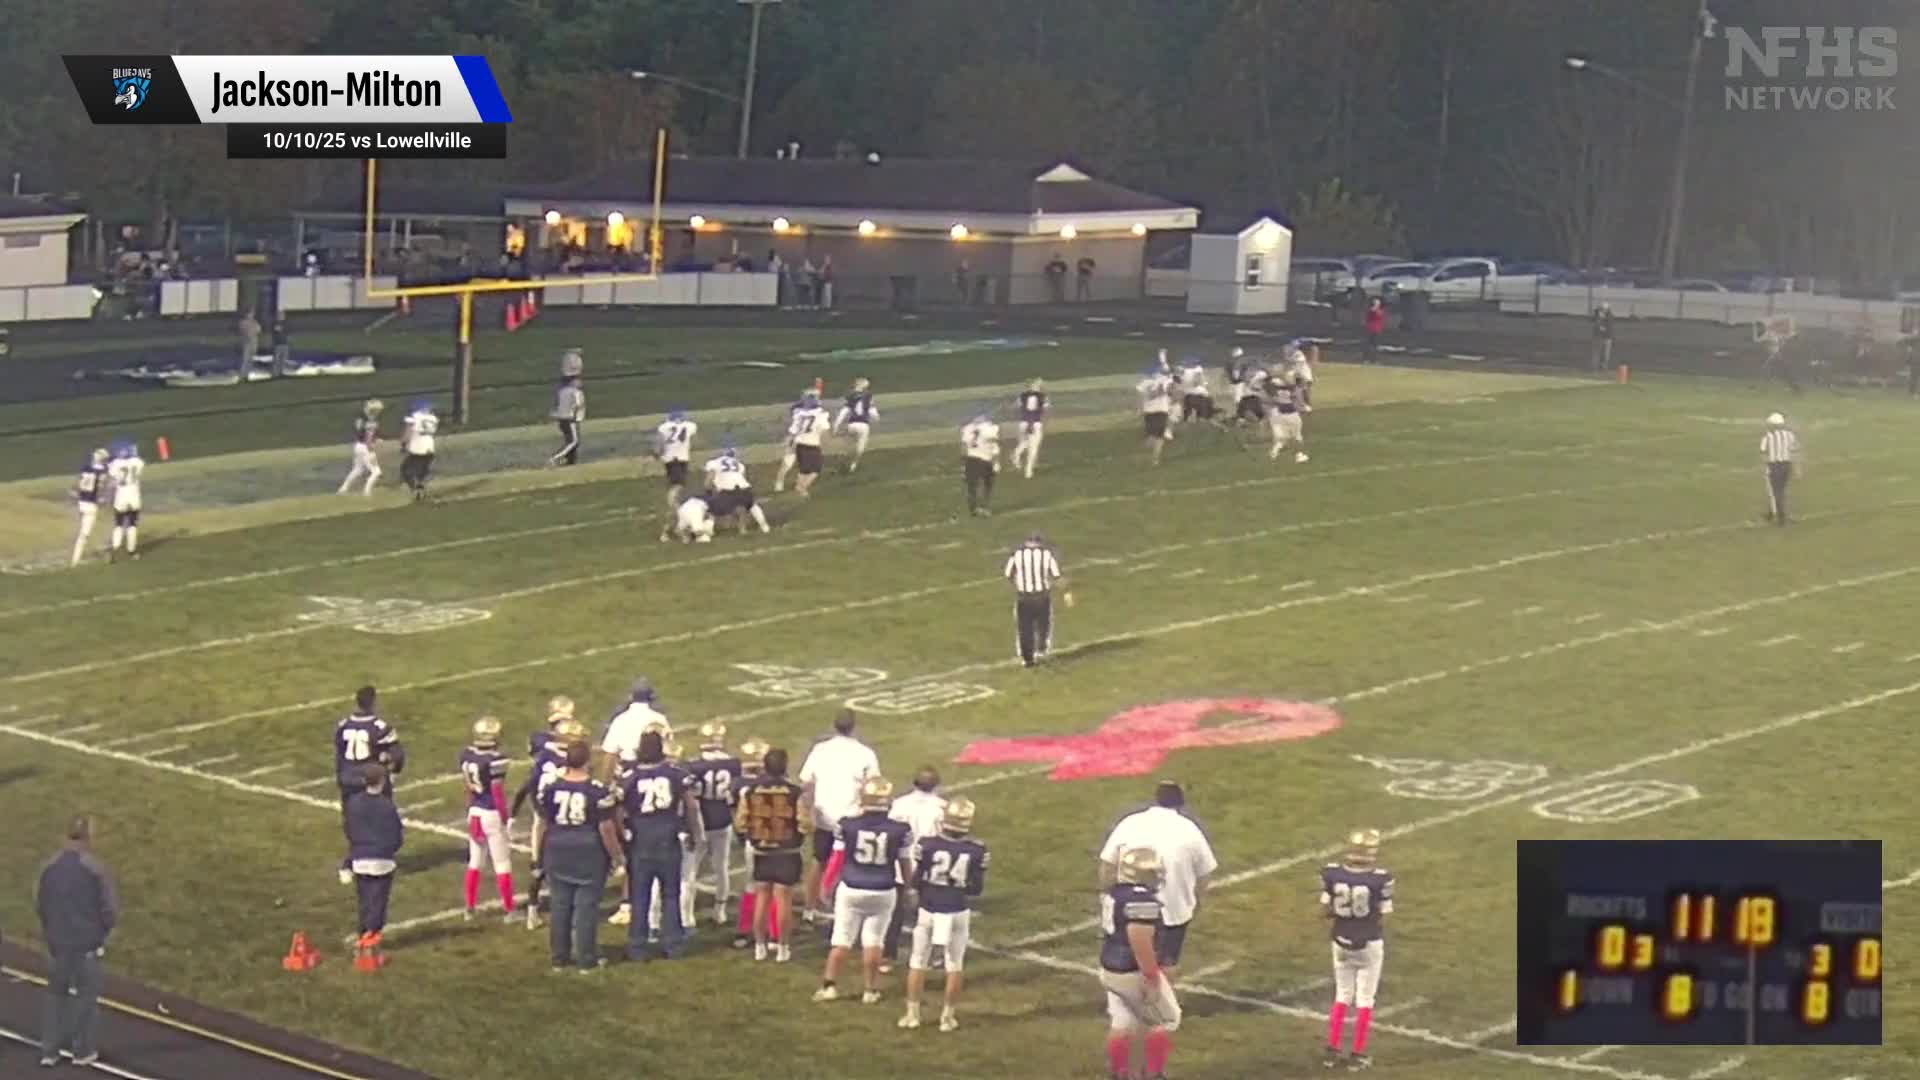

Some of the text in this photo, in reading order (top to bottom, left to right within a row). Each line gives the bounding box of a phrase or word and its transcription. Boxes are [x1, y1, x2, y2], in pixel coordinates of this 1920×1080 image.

[703, 769, 734, 806] 12
[553, 790, 589, 826] 78
[856, 830, 887, 866] 51
[927, 850, 972, 889] 24
[1333, 882, 1371, 918] 28
[1600, 926, 1625, 966] 0
